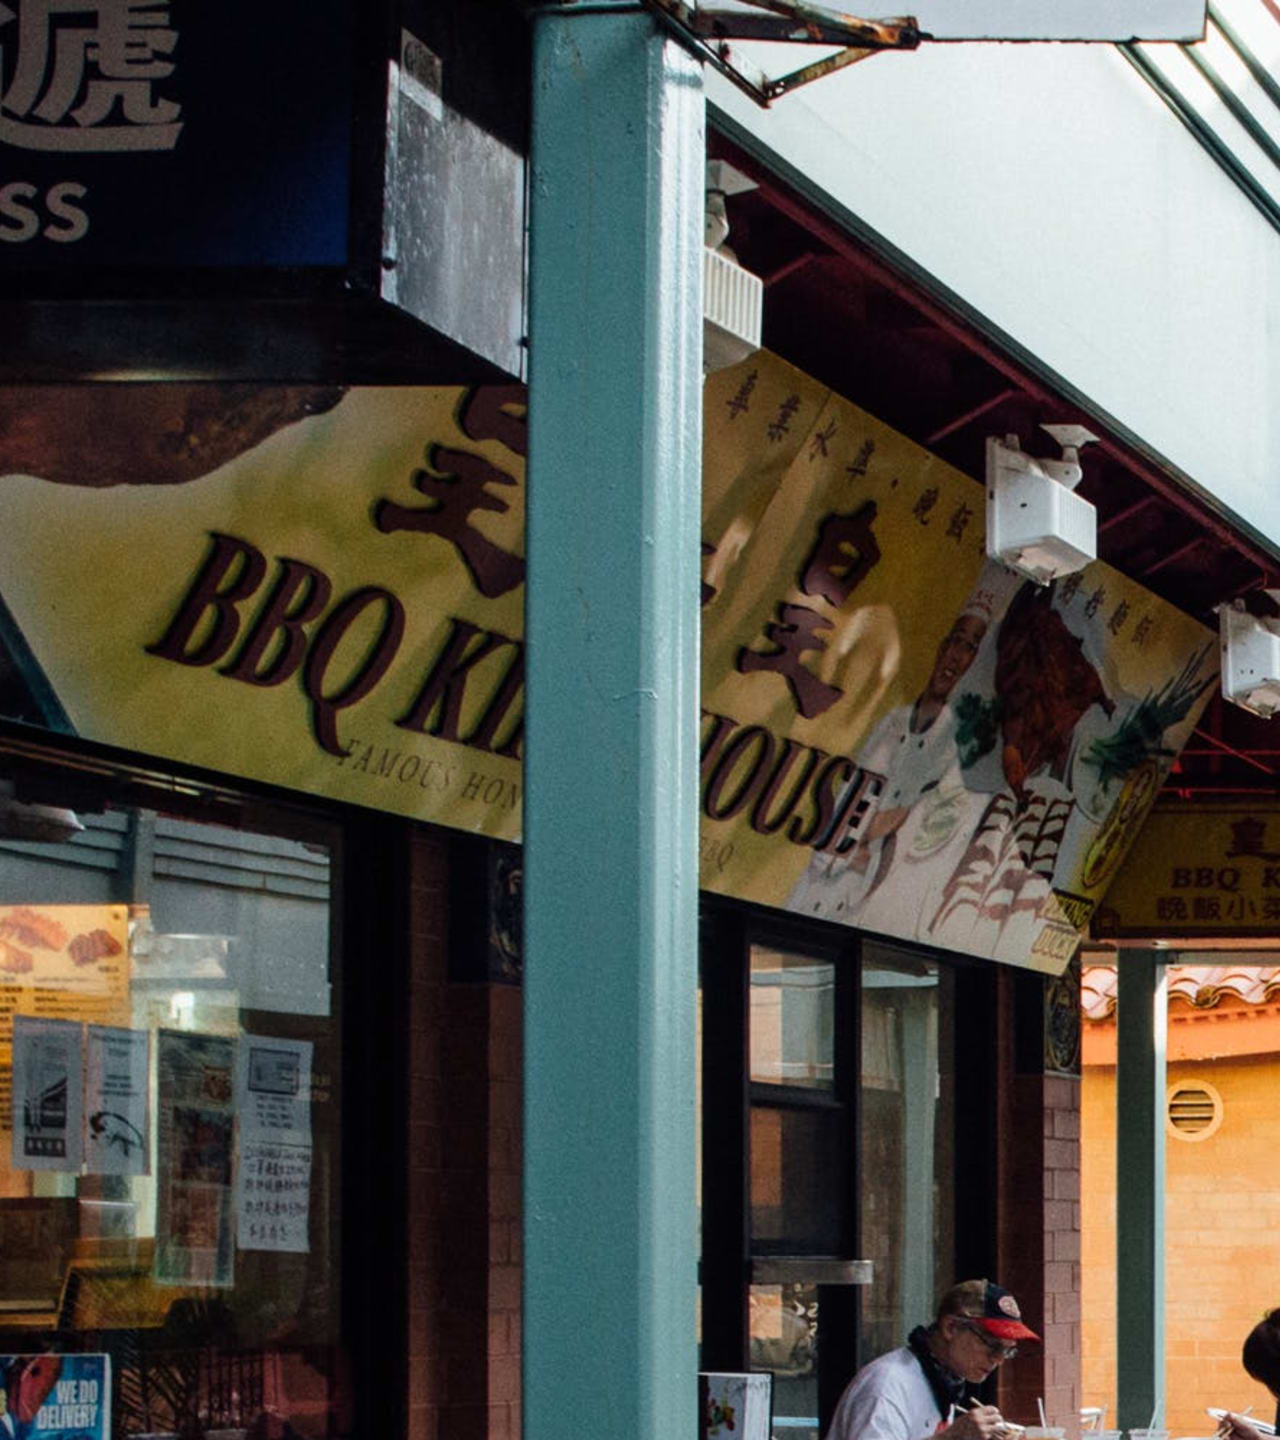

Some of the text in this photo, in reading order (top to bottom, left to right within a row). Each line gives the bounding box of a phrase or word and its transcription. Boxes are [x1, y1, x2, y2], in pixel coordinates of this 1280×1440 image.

[144, 529, 407, 758] BBQ
[392, 614, 523, 760] KI
[336, 737, 457, 793] FAMOUS
[1171, 866, 1242, 892] BBQ
[55, 1379, 99, 1404] WE DO
[36, 1404, 99, 1430] DELIVERY
